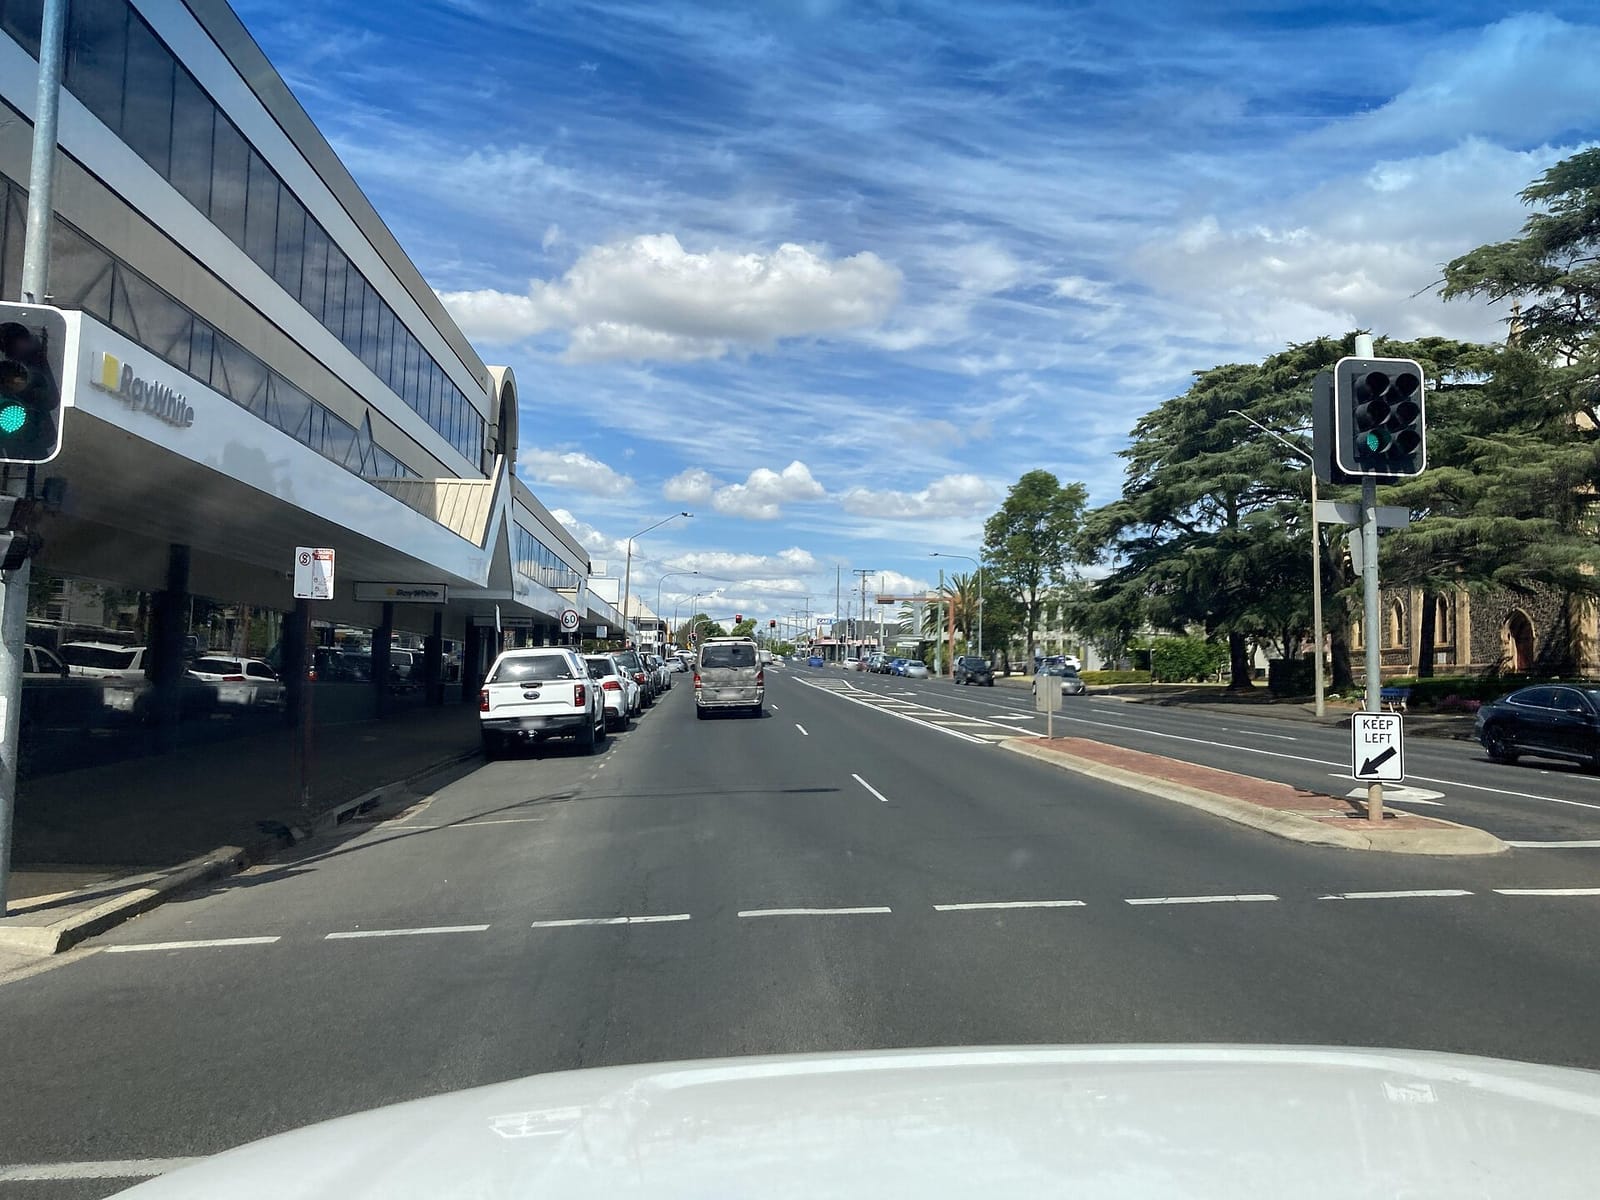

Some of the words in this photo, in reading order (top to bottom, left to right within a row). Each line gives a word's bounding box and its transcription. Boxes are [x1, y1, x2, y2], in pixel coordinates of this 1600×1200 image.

[565, 615, 576, 624] 60
[1362, 719, 1394, 730] KEEP
[1364, 733, 1392, 744] LEFT
